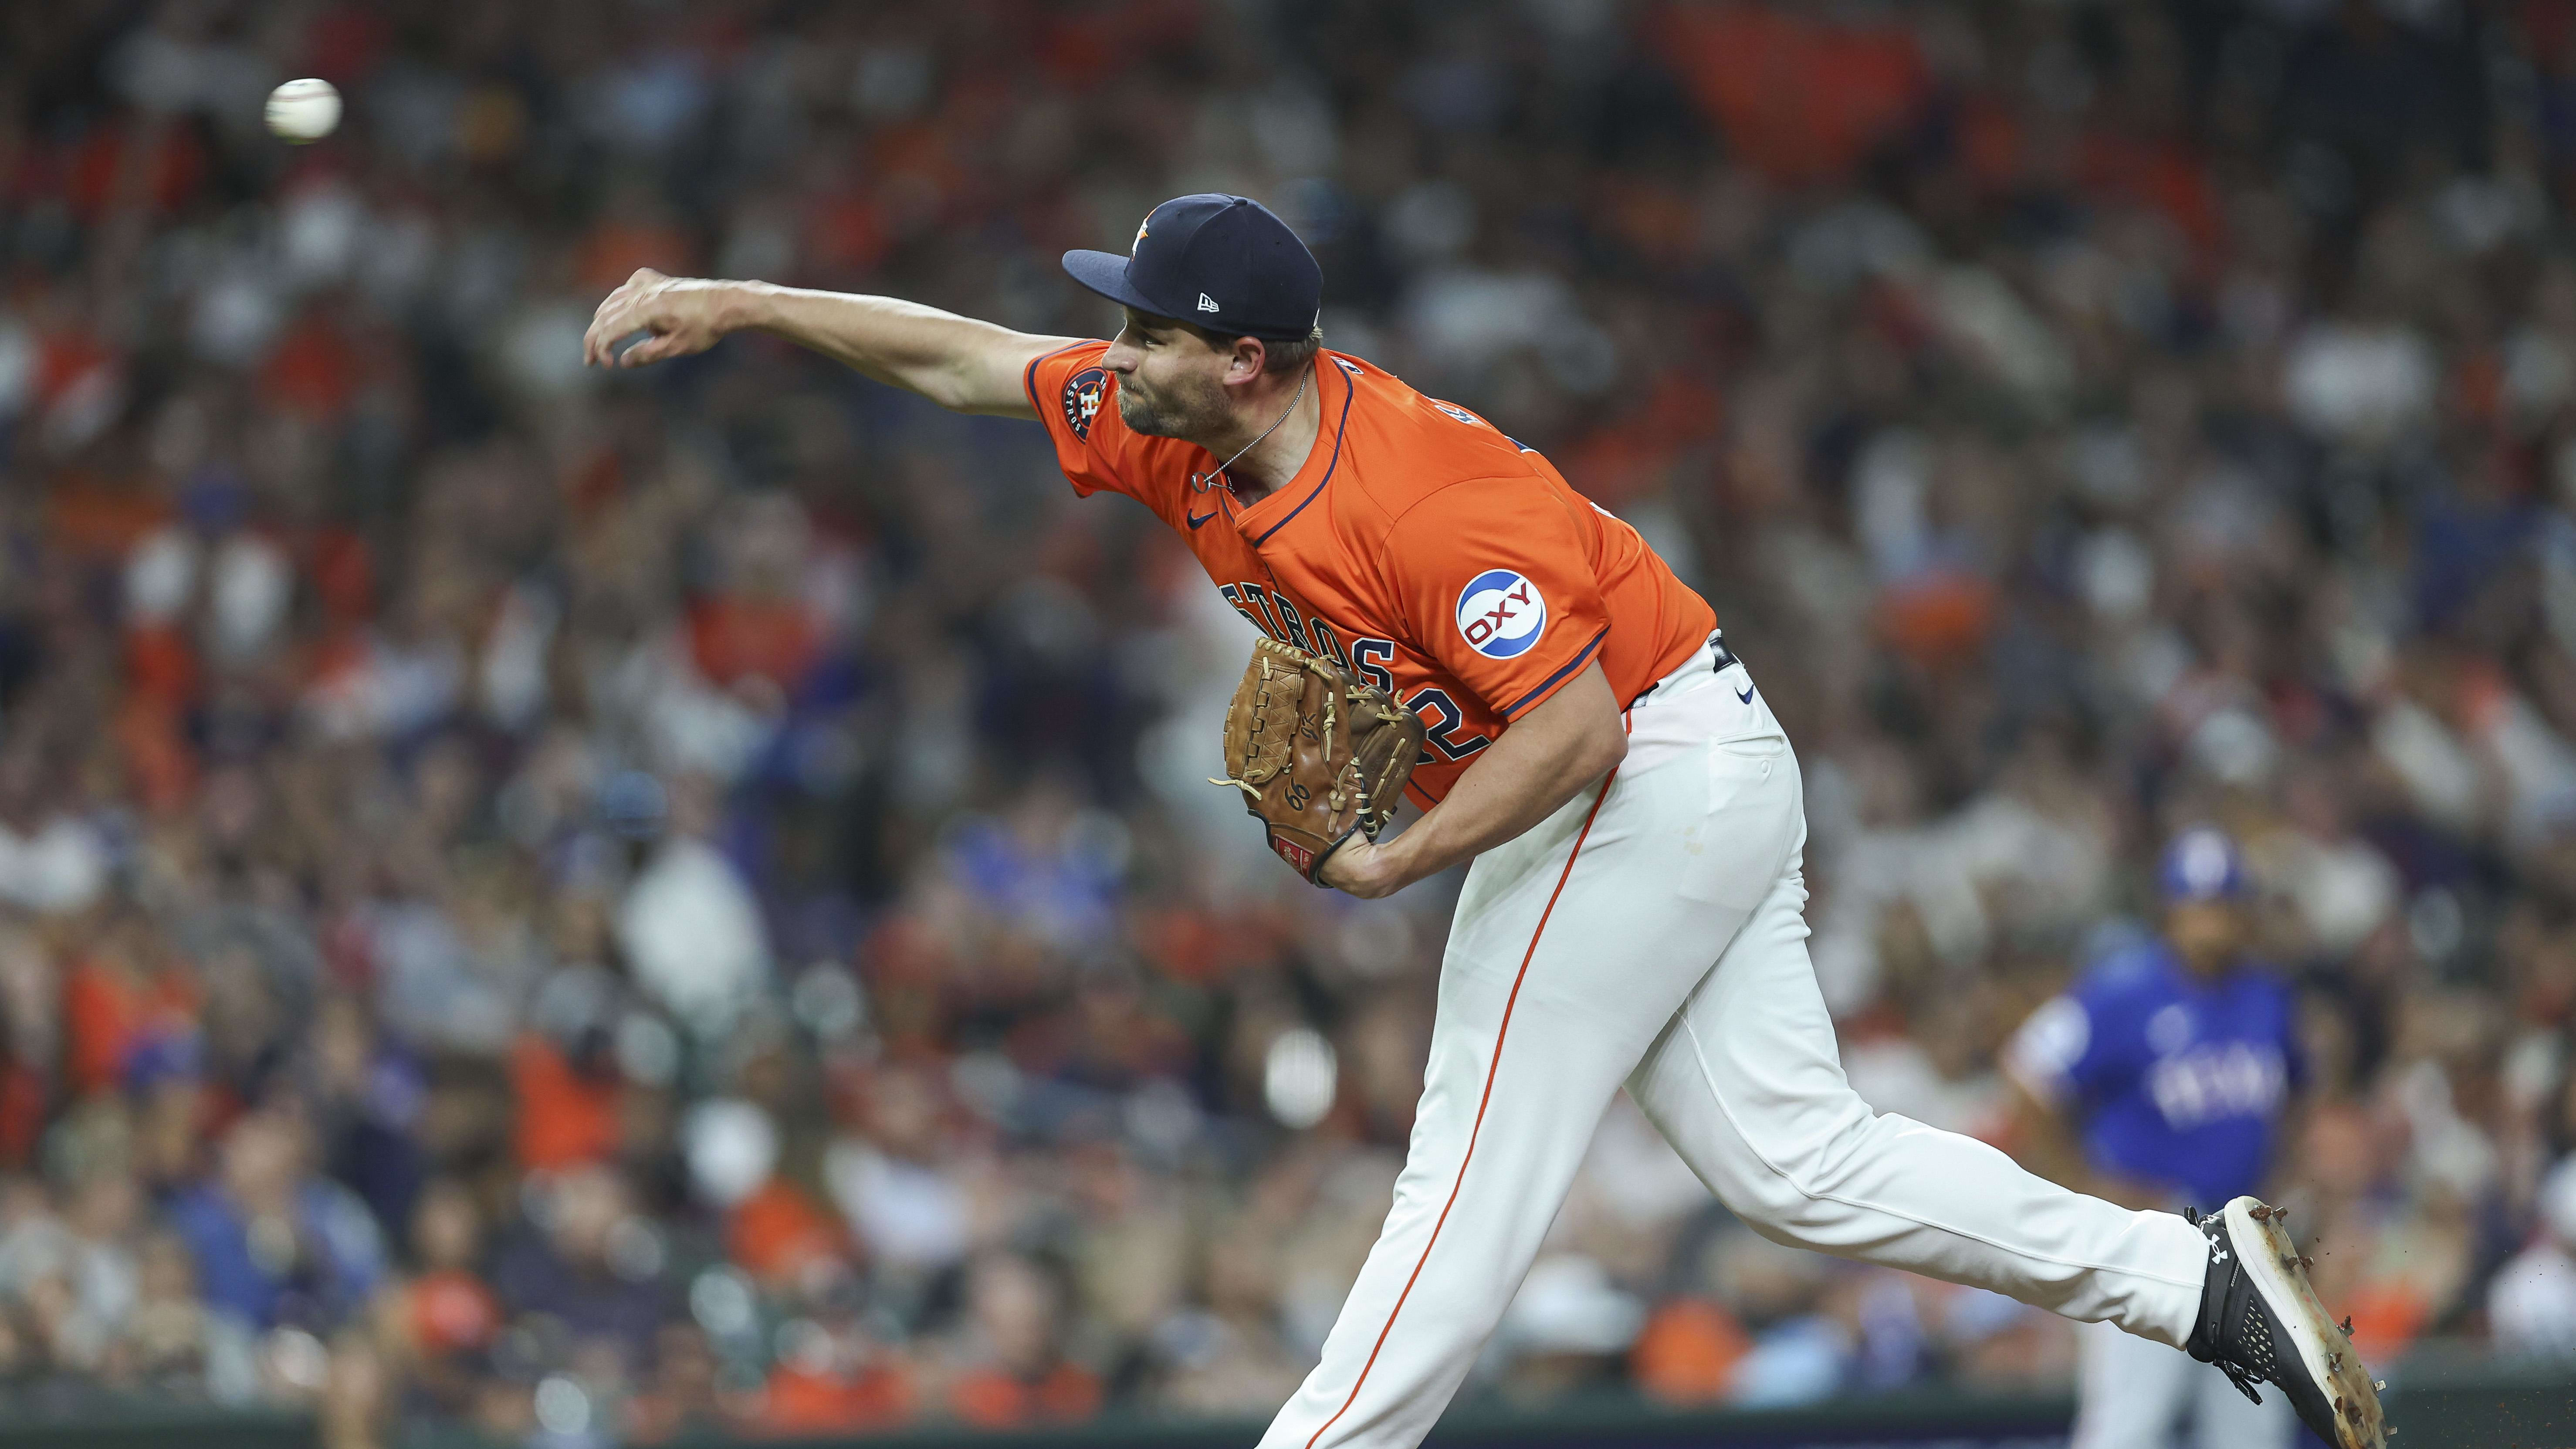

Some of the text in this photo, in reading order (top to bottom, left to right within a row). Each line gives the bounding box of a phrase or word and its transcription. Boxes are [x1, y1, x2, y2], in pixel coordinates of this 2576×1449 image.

[1066, 381, 1081, 432] ASTROS
[1080, 391, 1099, 419] H
[1464, 581, 1531, 645] OXY
[1404, 687, 1493, 765] 2
[1284, 776, 1311, 812] 66
